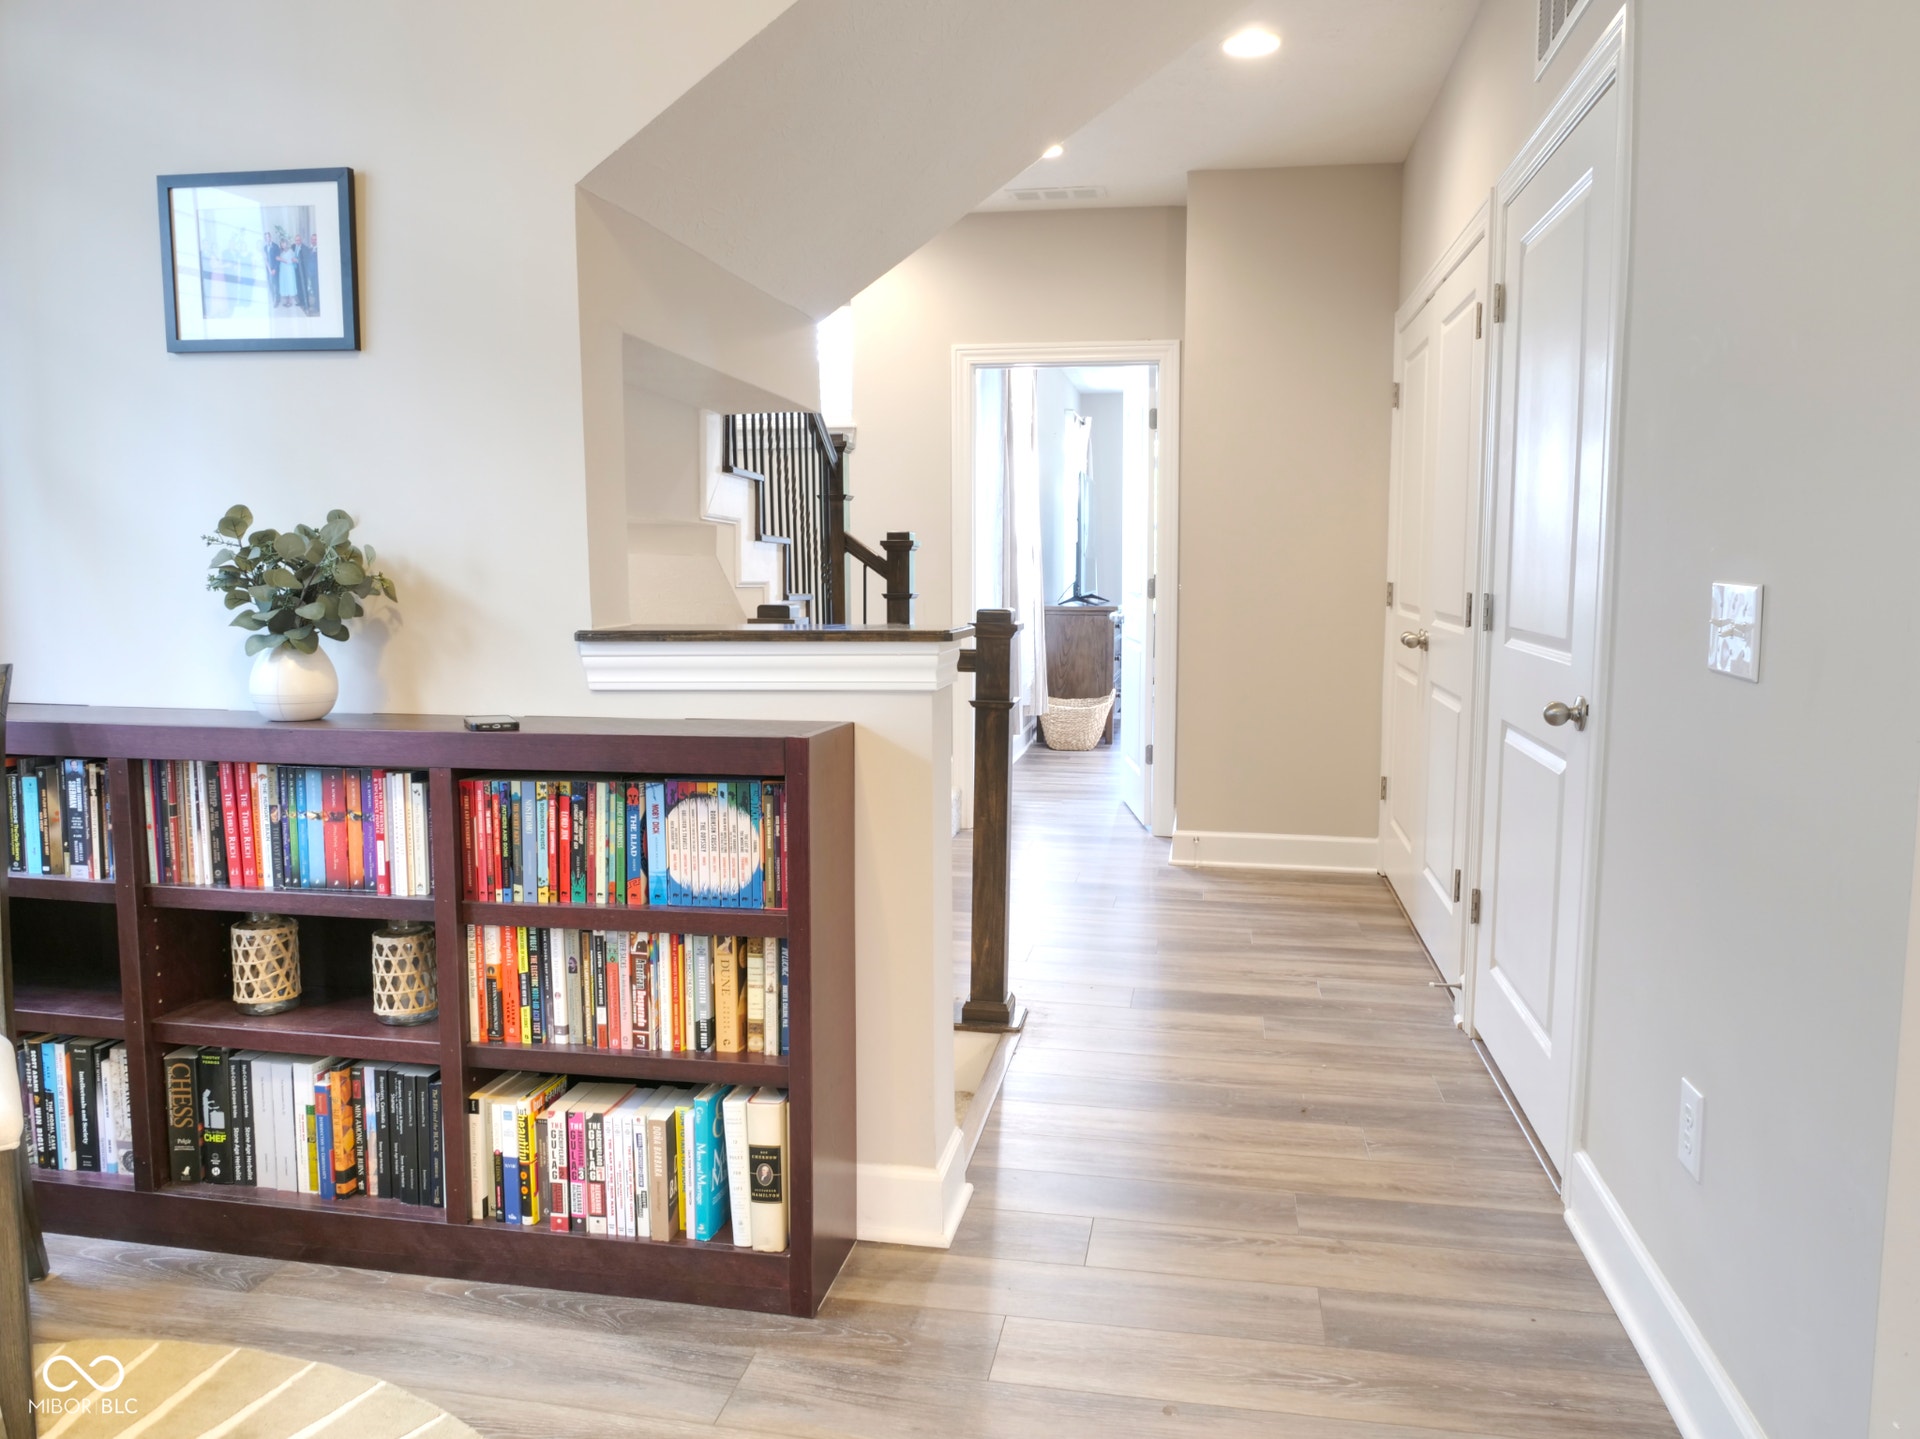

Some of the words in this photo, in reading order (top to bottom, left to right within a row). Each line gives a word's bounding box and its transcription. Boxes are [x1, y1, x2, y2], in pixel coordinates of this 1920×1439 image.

[68, 781, 77, 809] SHERMAN
[208, 779, 217, 807] TRUMP
[240, 793, 248, 808] THE
[226, 810, 234, 834] THIRD
[242, 811, 250, 834] THIRD
[525, 799, 533, 834] NOSTROMO
[560, 811, 568, 828] LORD
[652, 822, 660, 834] DICK
[698, 957, 706, 978] MICHAEL
[767, 942, 775, 978] SICILY
[636, 958, 647, 990] American
[720, 960, 731, 996] DUNE
[532, 1010, 540, 1021] ACID
[636, 990, 647, 1026] Desperado
[533, 1022, 541, 1034] TEST
[700, 1033, 708, 1049] WORLD
[78, 1071, 86, 1109] Intellectuals
[170, 1063, 194, 1128] CHESS
[35, 1107, 43, 1125] WIN
[36, 1128, 44, 1152] BIGLY
[204, 1134, 226, 1143] CHEF
[518, 1114, 529, 1163] beautiful
[653, 1126, 662, 1144] DOÑA
[680, 1128, 685, 1138] TO
[588, 1130, 596, 1181] GULAG
[654, 1146, 662, 1177] BARBARA
[681, 1156, 686, 1165] TO
[696, 1142, 706, 1161] Men
[578, 1170, 584, 1180] 3
[696, 1161, 704, 1174] and
[696, 1174, 707, 1206] Marriage
